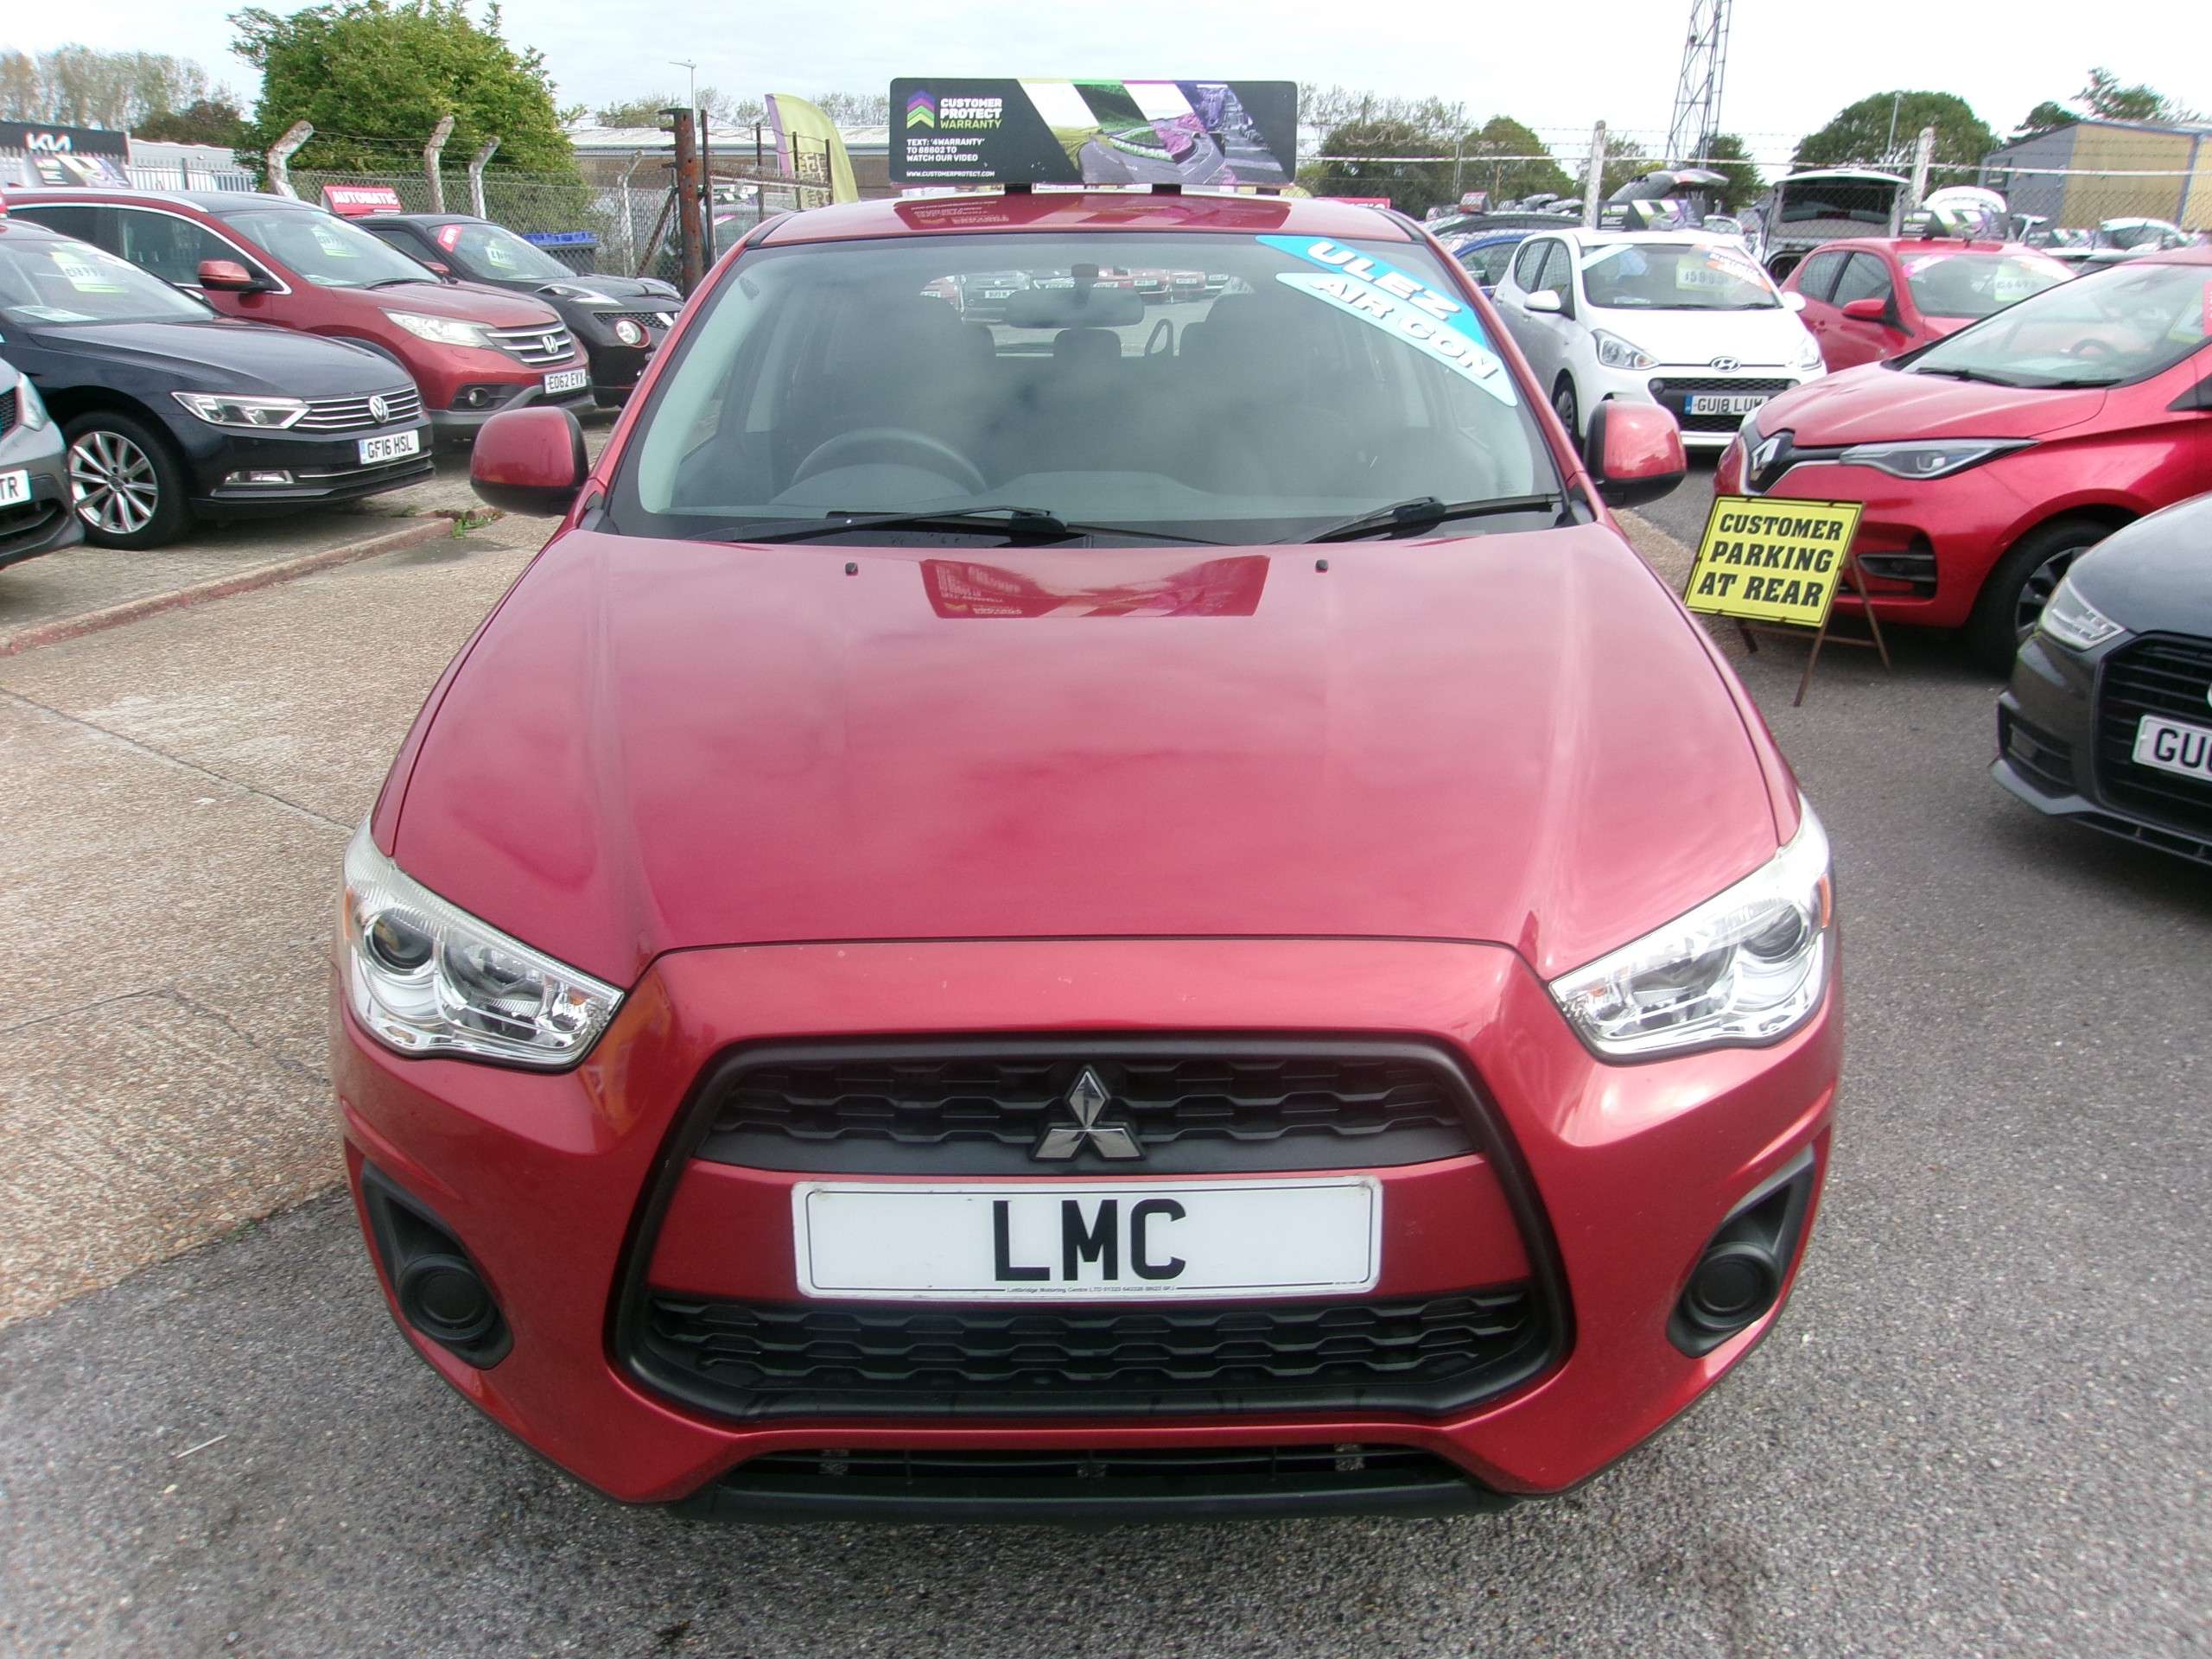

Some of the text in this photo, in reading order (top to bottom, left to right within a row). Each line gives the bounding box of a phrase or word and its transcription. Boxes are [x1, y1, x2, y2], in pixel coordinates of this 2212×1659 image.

[940, 98, 1002, 108] CUSTOMER
[940, 108, 1002, 119] PROTECT
[940, 119, 1002, 129] WARRANTY
[332, 191, 398, 205] AUTOMATIC
[1306, 241, 1462, 321] ULEZ
[1307, 275, 1499, 380] AIR CON
[1697, 397, 1729, 412] GU18
[367, 435, 413, 458] GF16 HSL
[1719, 513, 1843, 541] CUSTOMER
[1709, 540, 1834, 573] PARKING
[1697, 571, 1824, 607] AT REAR
[2154, 728, 2212, 773] GU
[993, 1198, 1186, 1281] LMC
